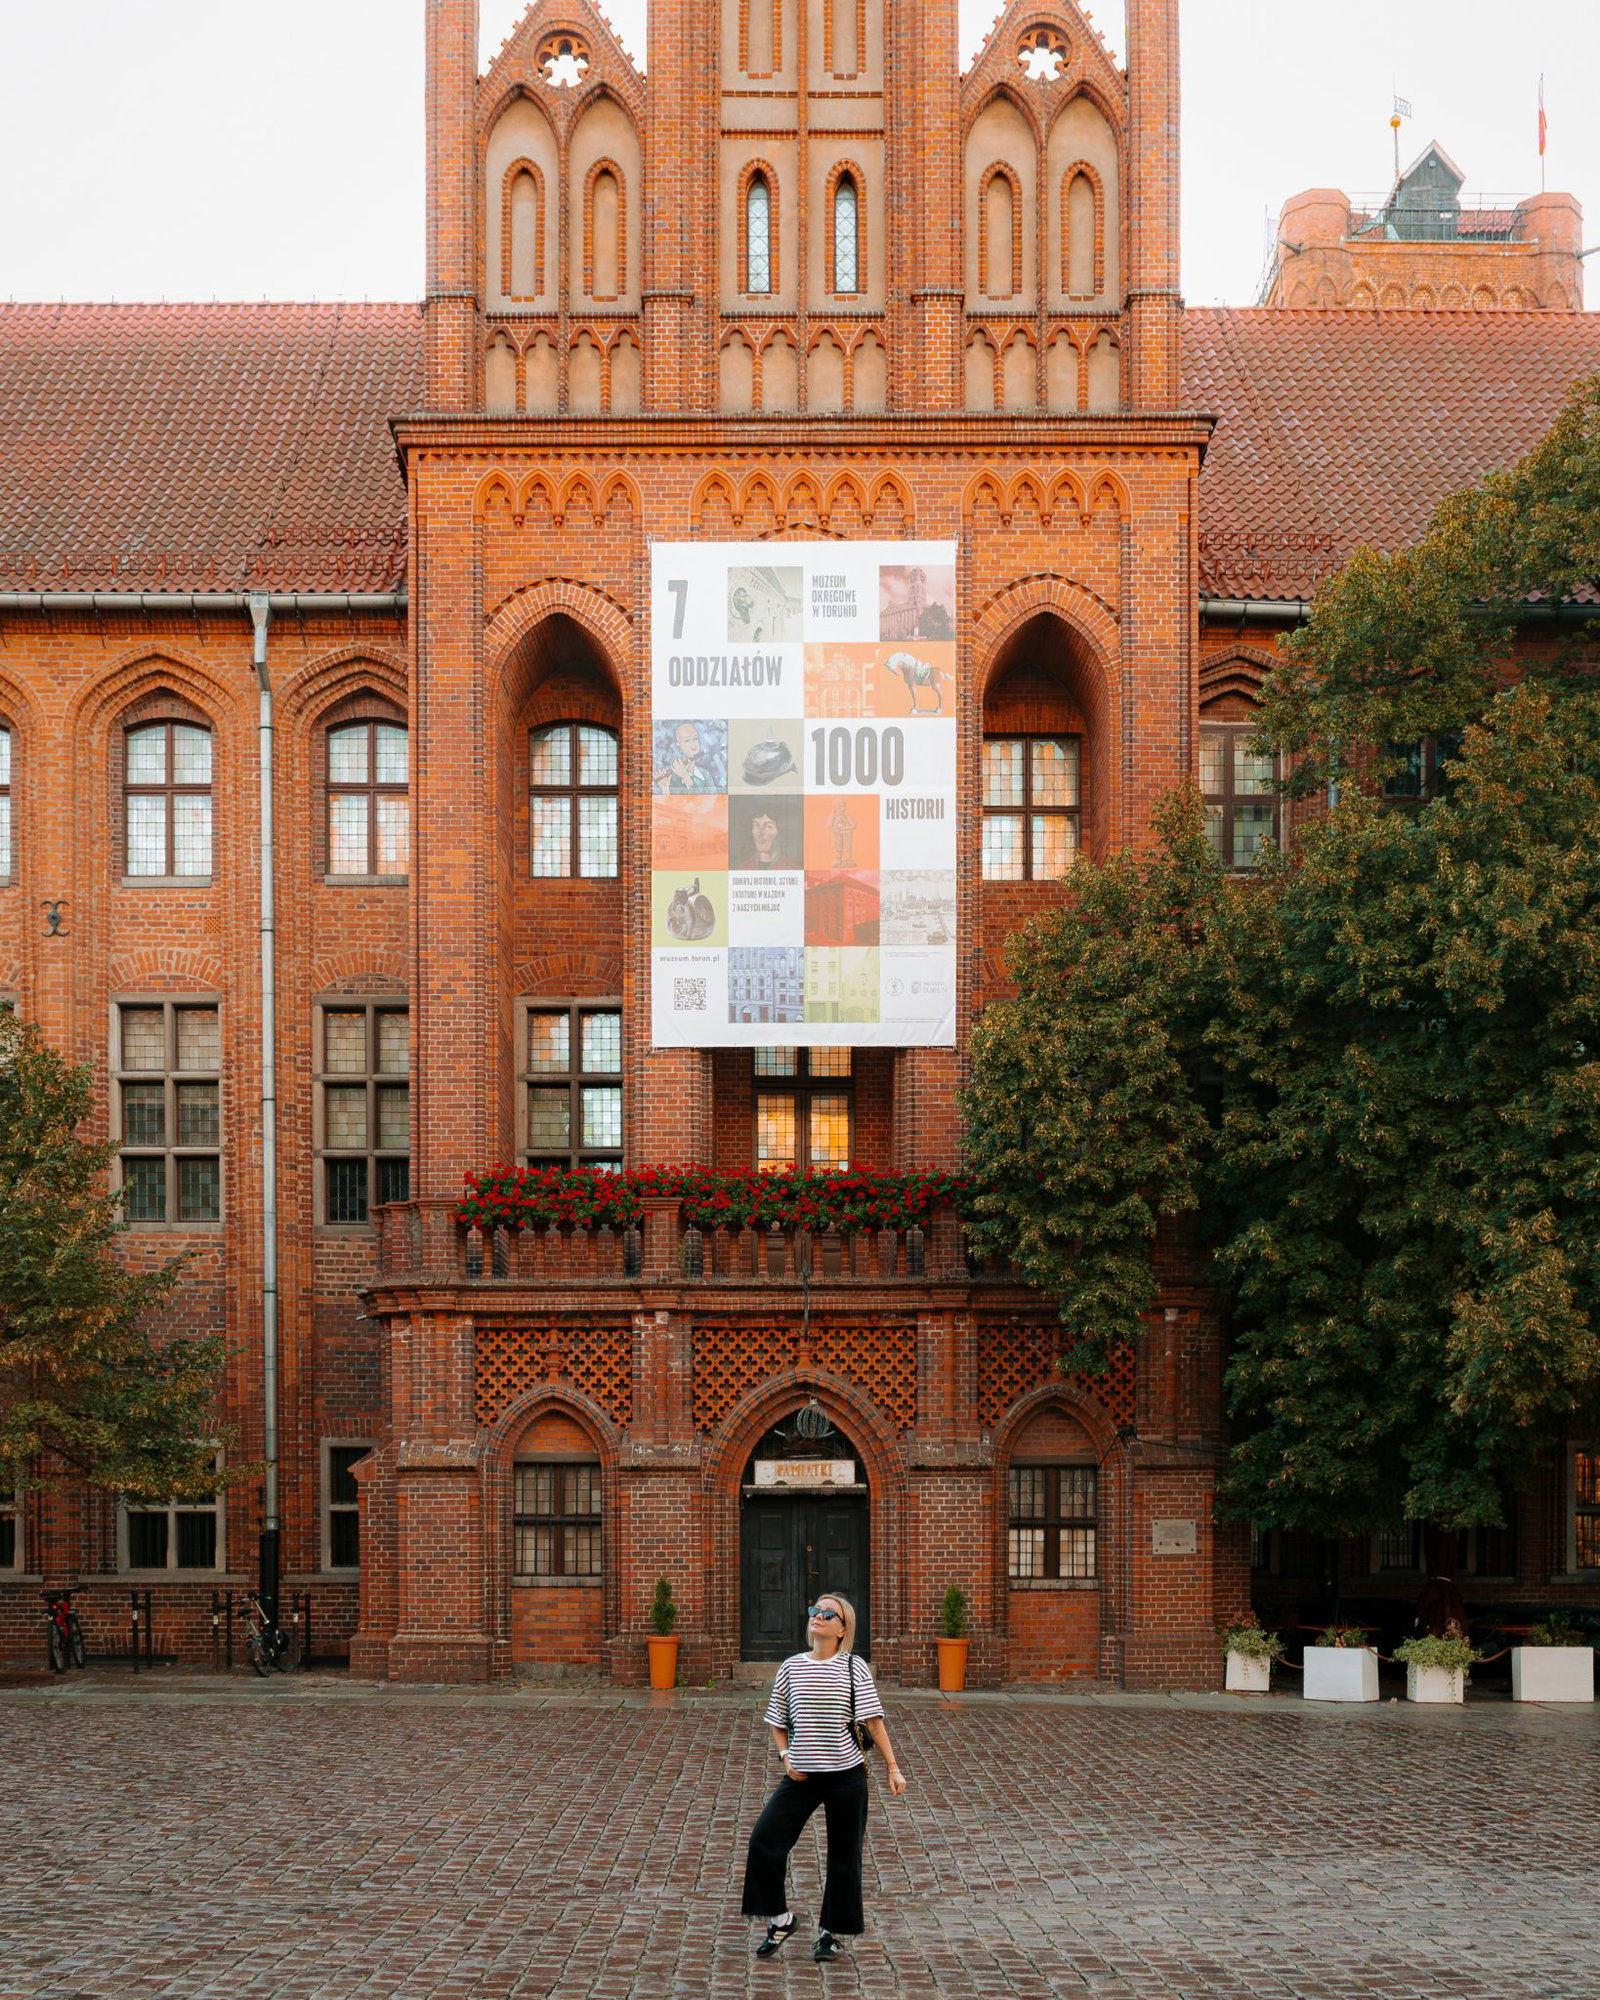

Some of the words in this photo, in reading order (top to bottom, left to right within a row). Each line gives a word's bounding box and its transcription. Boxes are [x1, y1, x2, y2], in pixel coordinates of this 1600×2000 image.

[812, 575, 846, 588] MUZEUM
[812, 589, 856, 604] OKRĘGOWE
[668, 579, 689, 640] 7
[812, 605, 820, 618] W
[822, 605, 857, 618] TORUNIU
[668, 650, 783, 687] ODDZIAŁÓW
[811, 726, 904, 786] 1000
[885, 798, 945, 820] HISTORII
